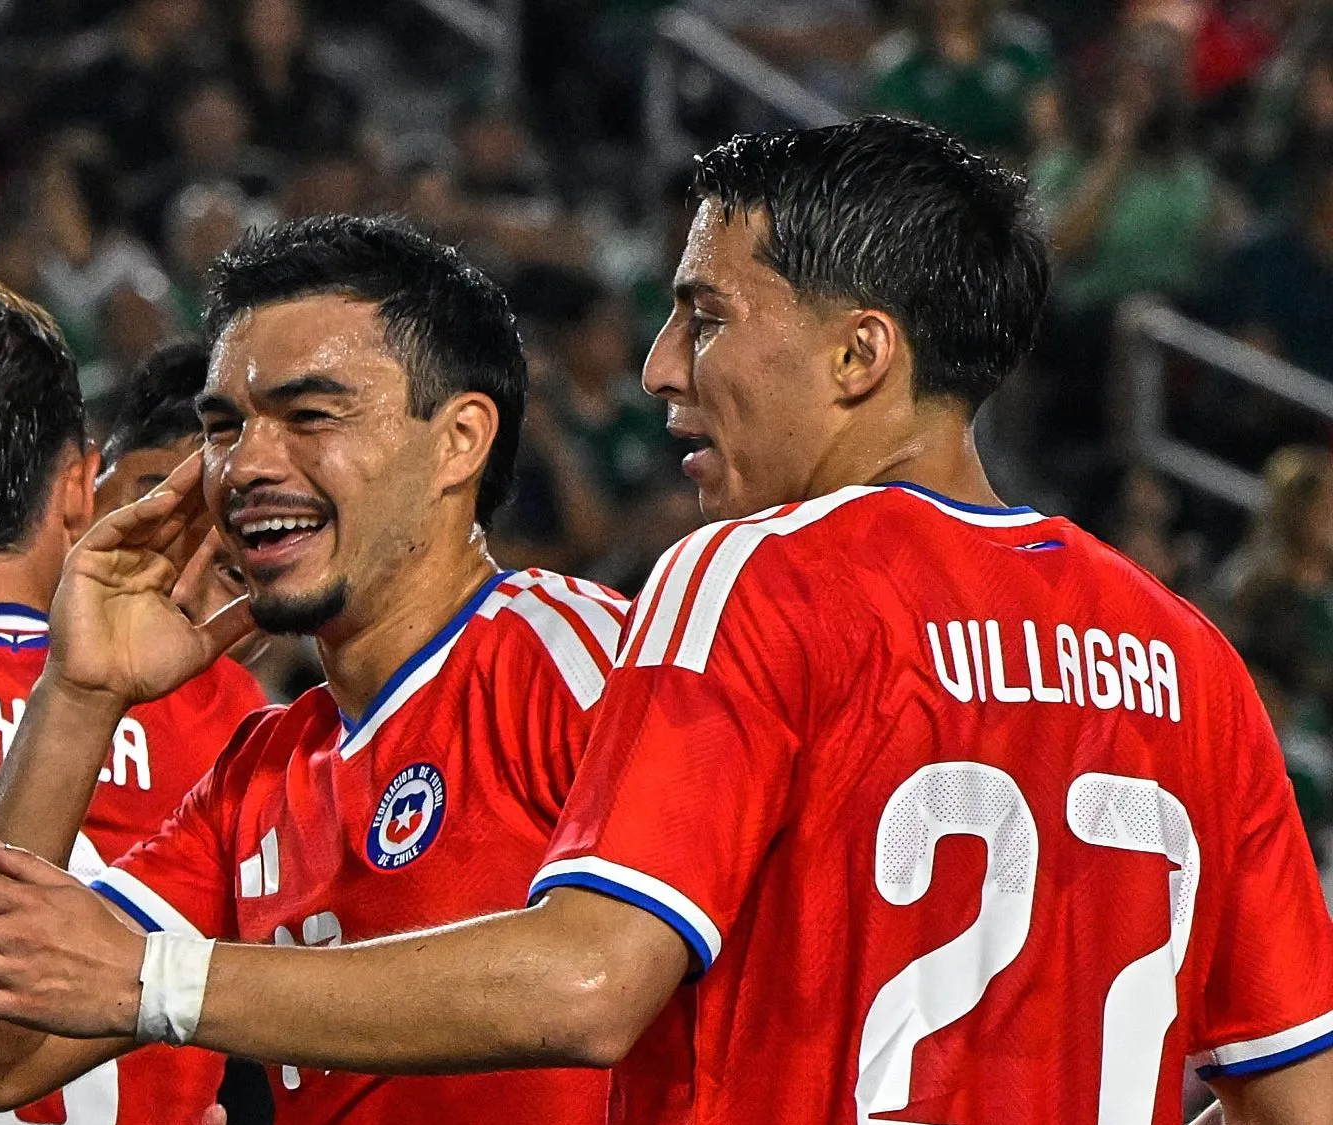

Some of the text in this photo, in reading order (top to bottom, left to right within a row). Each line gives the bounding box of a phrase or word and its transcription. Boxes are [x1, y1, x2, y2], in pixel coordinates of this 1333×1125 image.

[926, 619, 1180, 723] VILLAGRA
[373, 766, 443, 827] FEDERACION DE FUTBOL
[378, 845, 418, 867] DE CHILE
